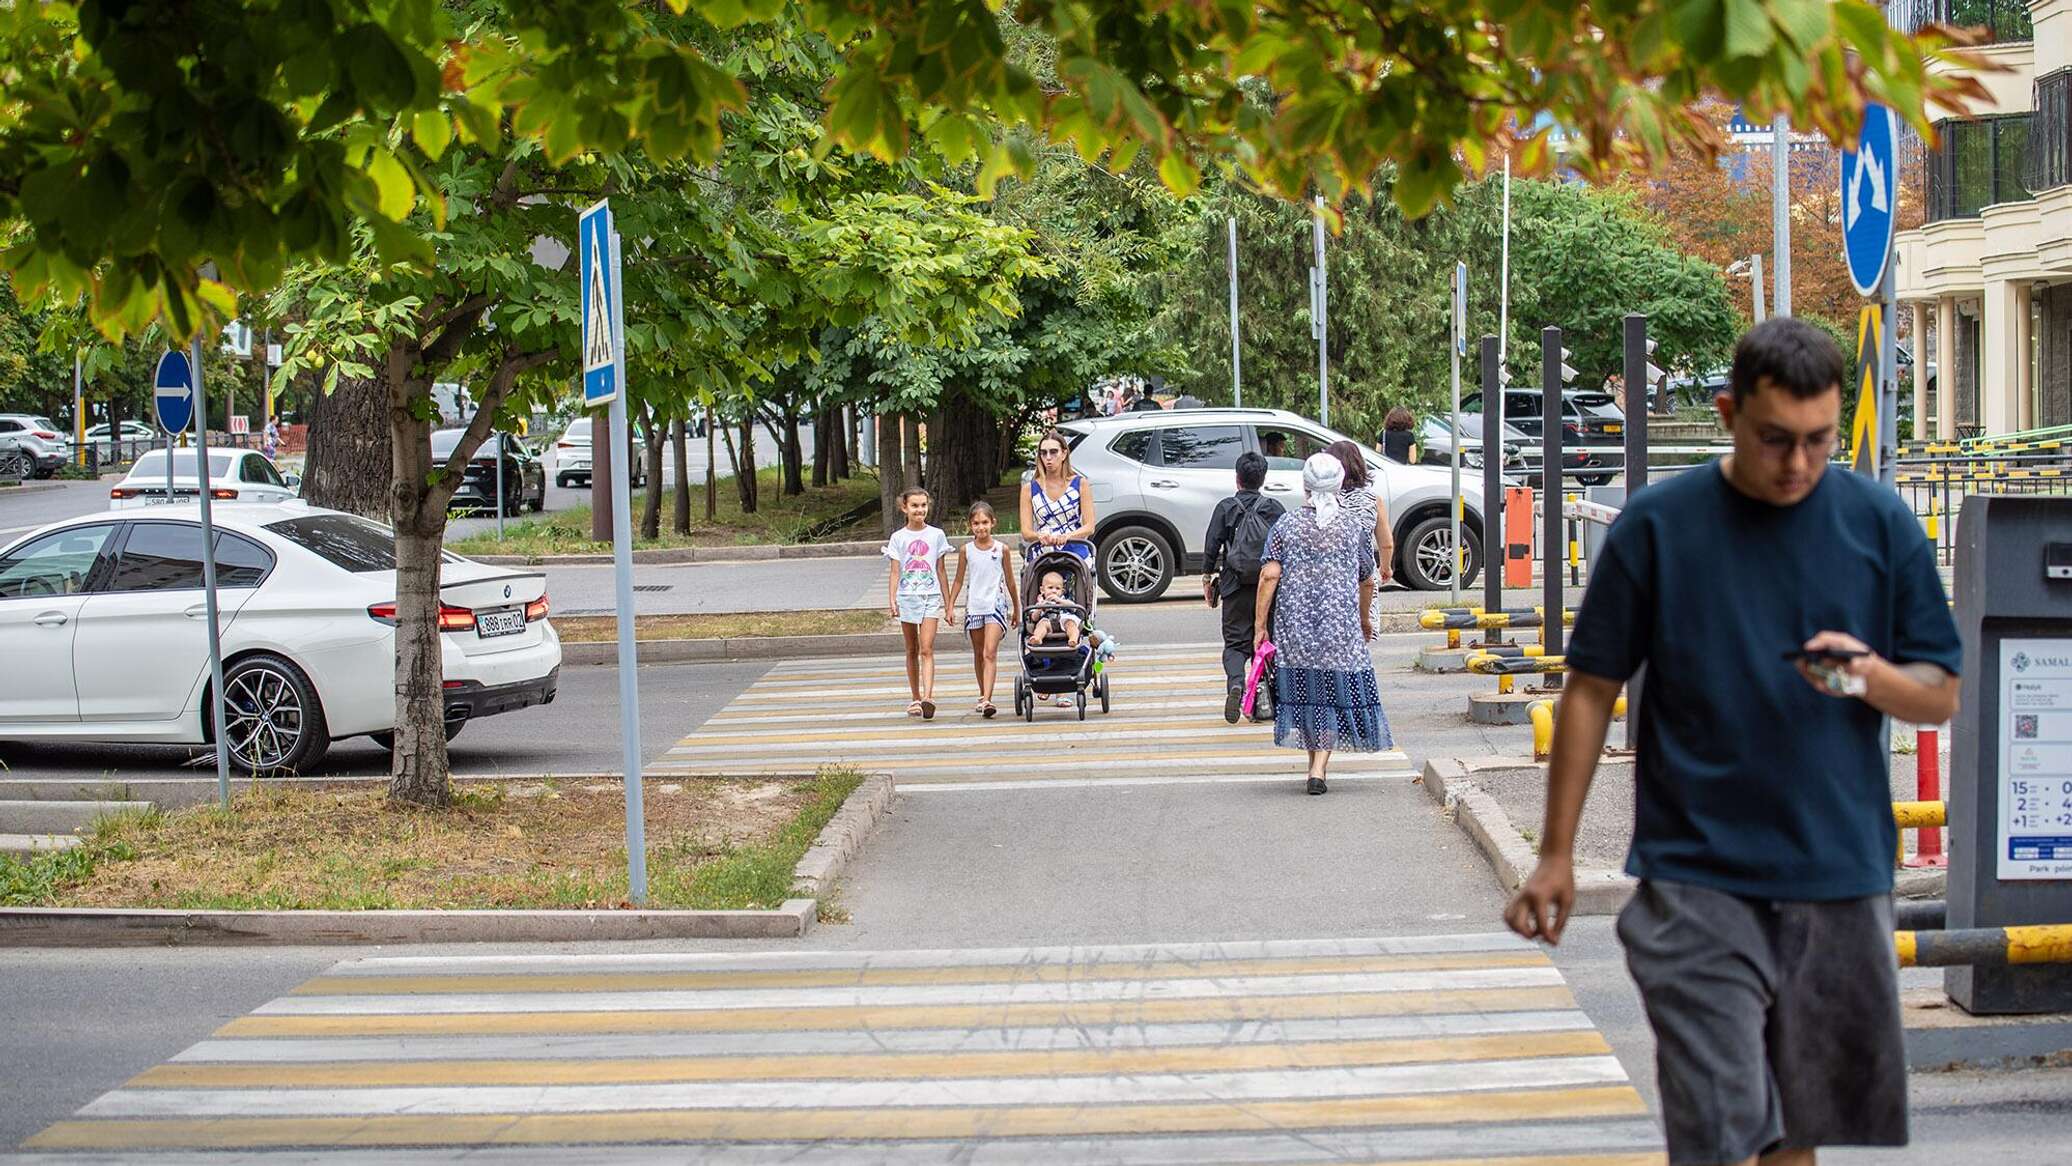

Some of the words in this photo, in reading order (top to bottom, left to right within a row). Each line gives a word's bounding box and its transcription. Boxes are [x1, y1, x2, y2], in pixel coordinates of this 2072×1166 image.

[2012, 781, 2028, 795] 15
[2018, 798, 2027, 811] 2
[2013, 815, 2027, 828] +1
